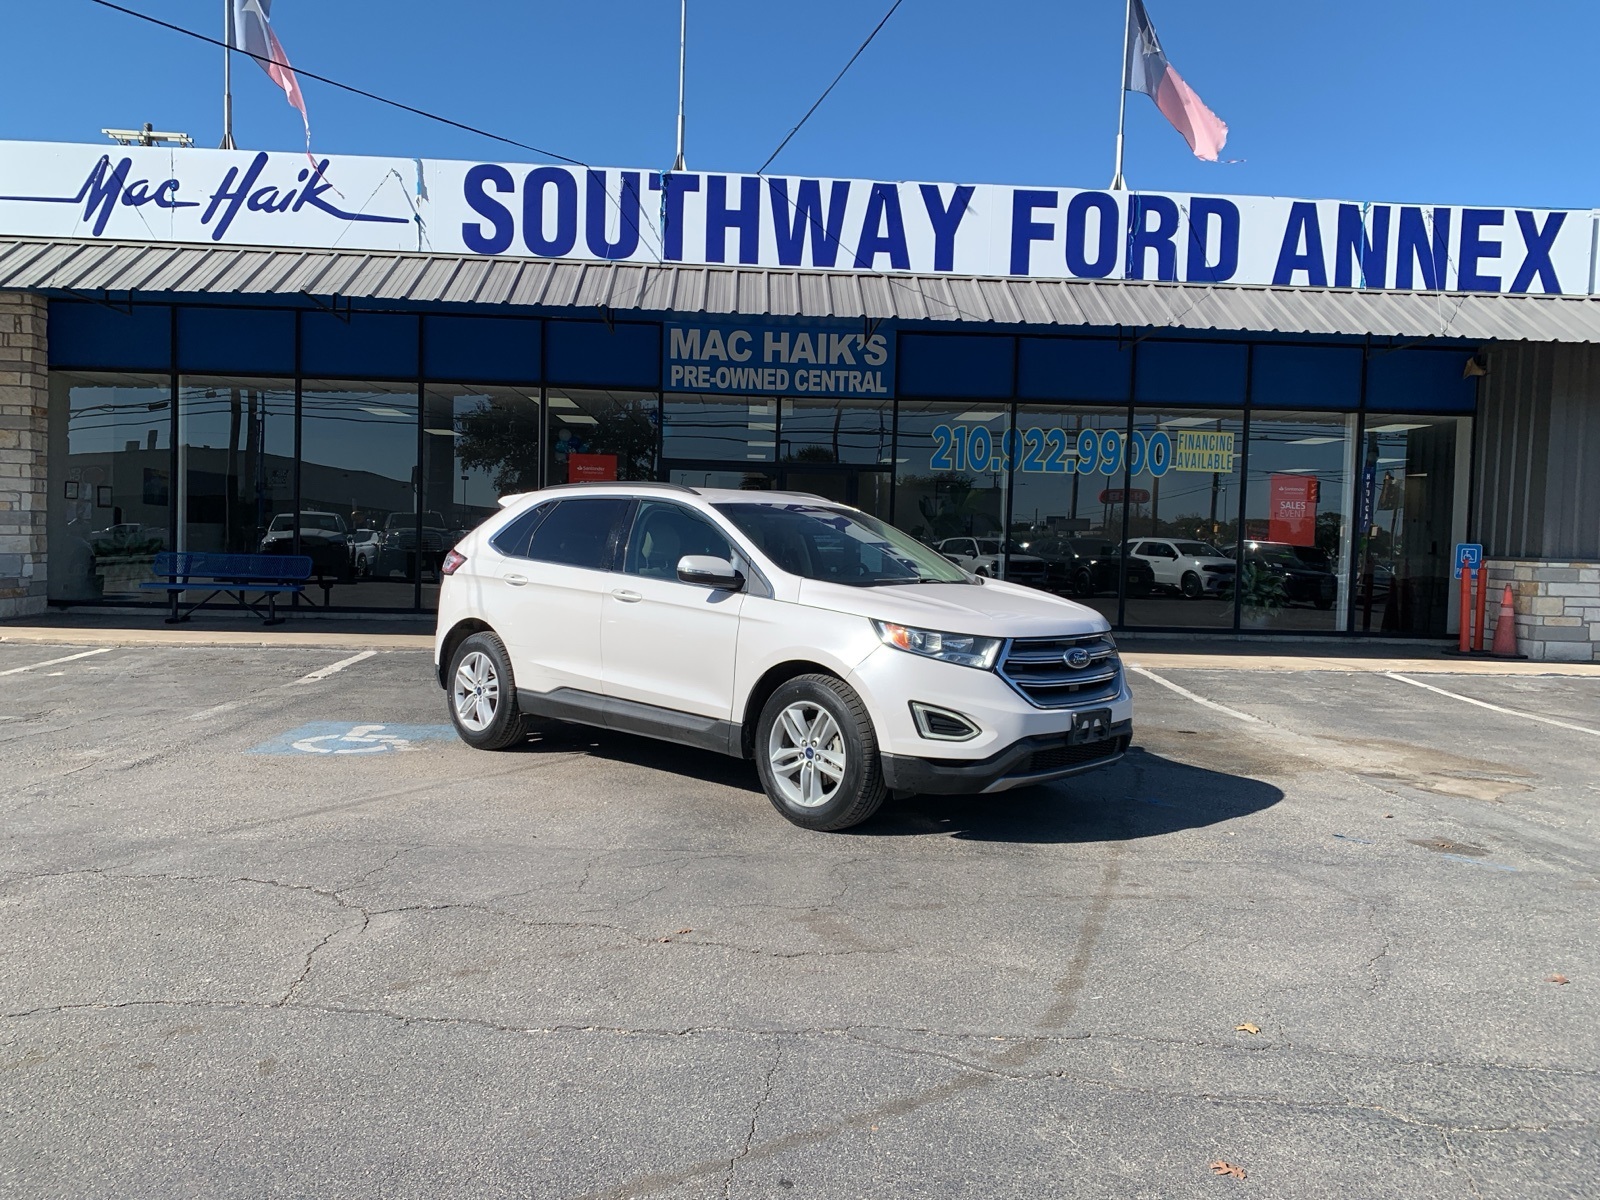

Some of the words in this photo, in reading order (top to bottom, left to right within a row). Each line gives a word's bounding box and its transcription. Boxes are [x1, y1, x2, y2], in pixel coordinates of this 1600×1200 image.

[76, 153, 200, 237] Mac
[200, 151, 409, 241] Haik
[462, 163, 976, 273] SOUTHWAY
[1009, 188, 1241, 282] FORD
[1271, 200, 1568, 294] ANNEX
[670, 328, 753, 361] MAC
[763, 331, 888, 366] HAIK'S
[670, 364, 789, 390] PRE-OWNED
[794, 369, 888, 393] CENTRAL
[929, 424, 1172, 478] 210.922.9900
[1178, 433, 1233, 451] FINANCING
[1177, 452, 1233, 471] AVAILABLE
[1280, 500, 1306, 510] SALES
[1280, 509, 1306, 517] EVENT
